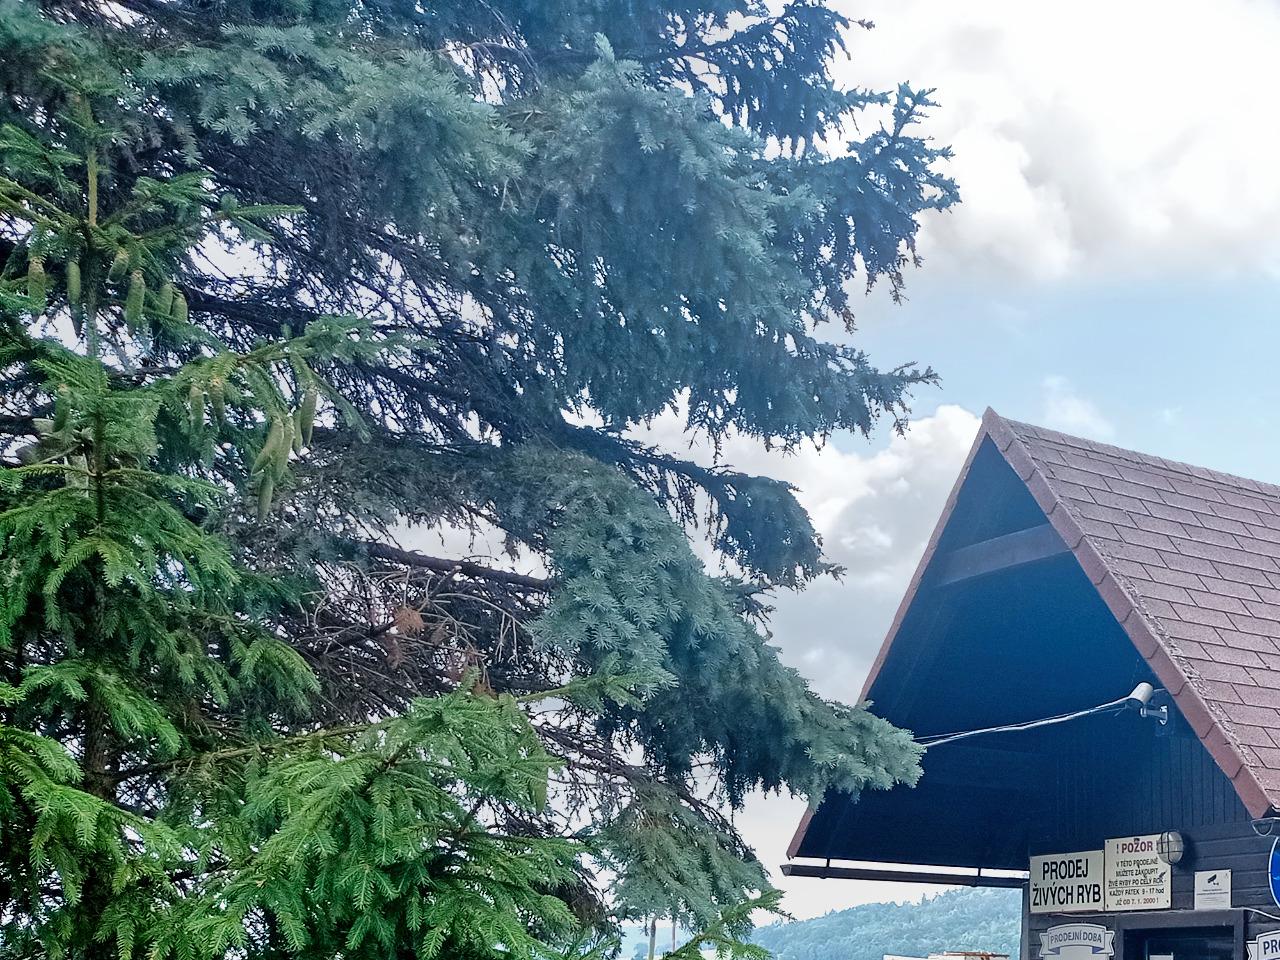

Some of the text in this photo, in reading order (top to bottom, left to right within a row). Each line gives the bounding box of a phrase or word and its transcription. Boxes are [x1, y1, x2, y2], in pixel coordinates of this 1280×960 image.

[1042, 858, 1089, 880] PRODEJ
[1032, 882, 1101, 906] ŽIVÝCH RYB
[1050, 930, 1102, 944] PRODEJNÍ DOBA
